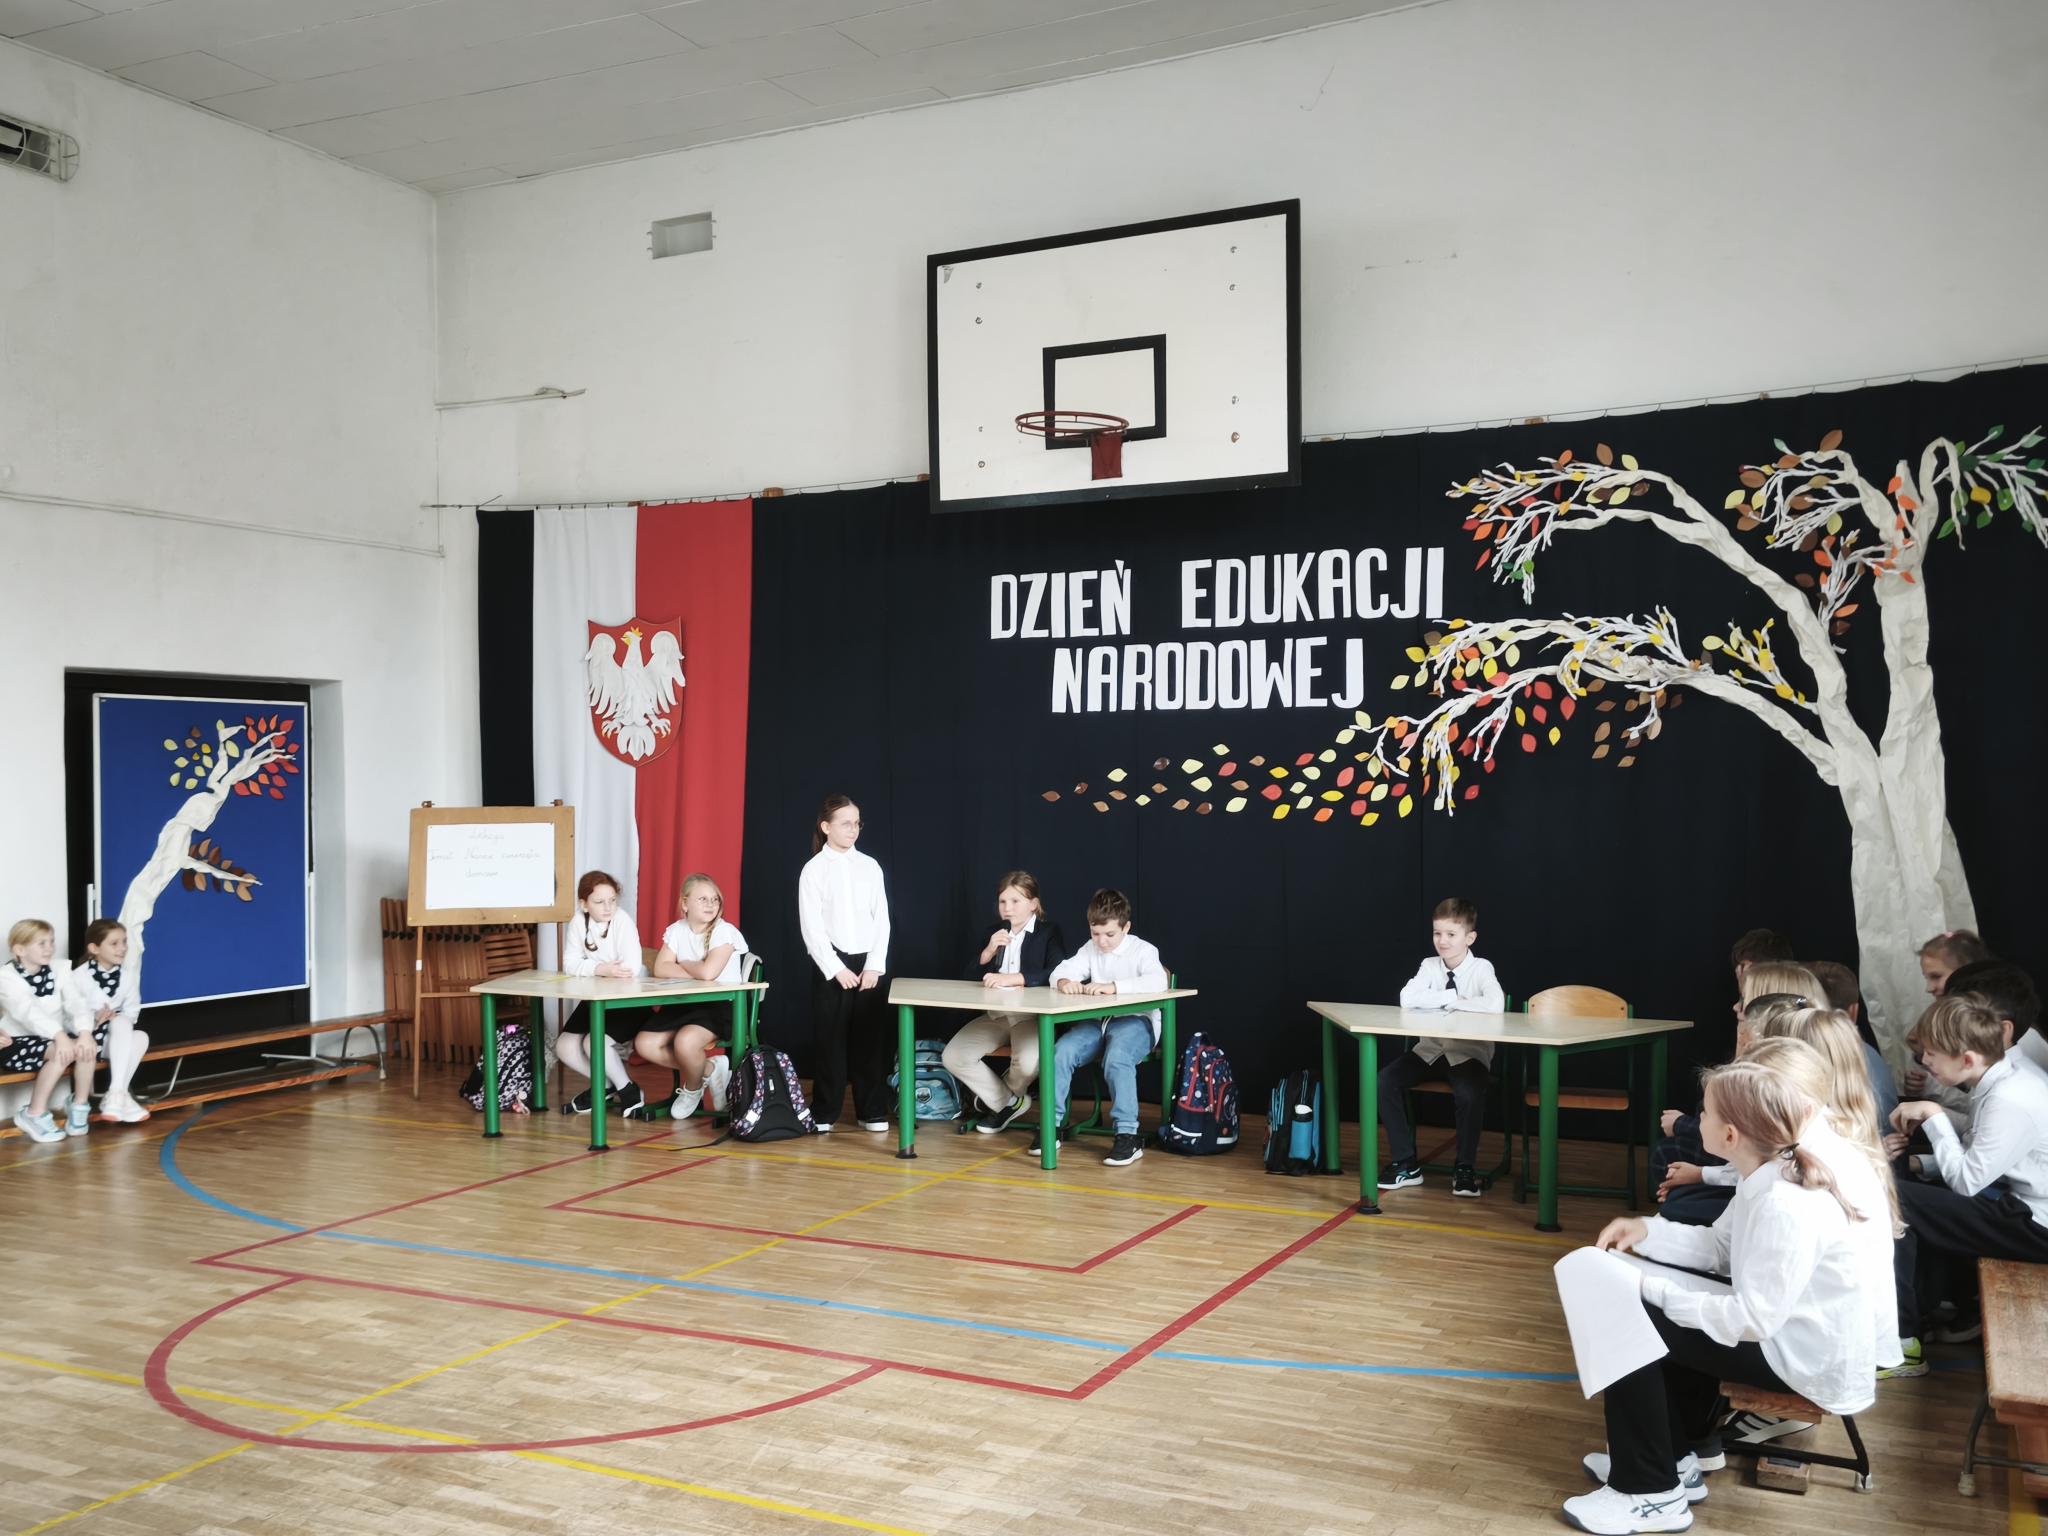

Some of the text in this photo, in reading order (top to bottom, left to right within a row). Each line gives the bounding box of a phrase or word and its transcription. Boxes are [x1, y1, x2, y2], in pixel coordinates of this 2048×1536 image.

[990, 546, 1445, 640] DZIEŃ EDUKACJI
[1051, 636, 1365, 714] NARODOWEJ
